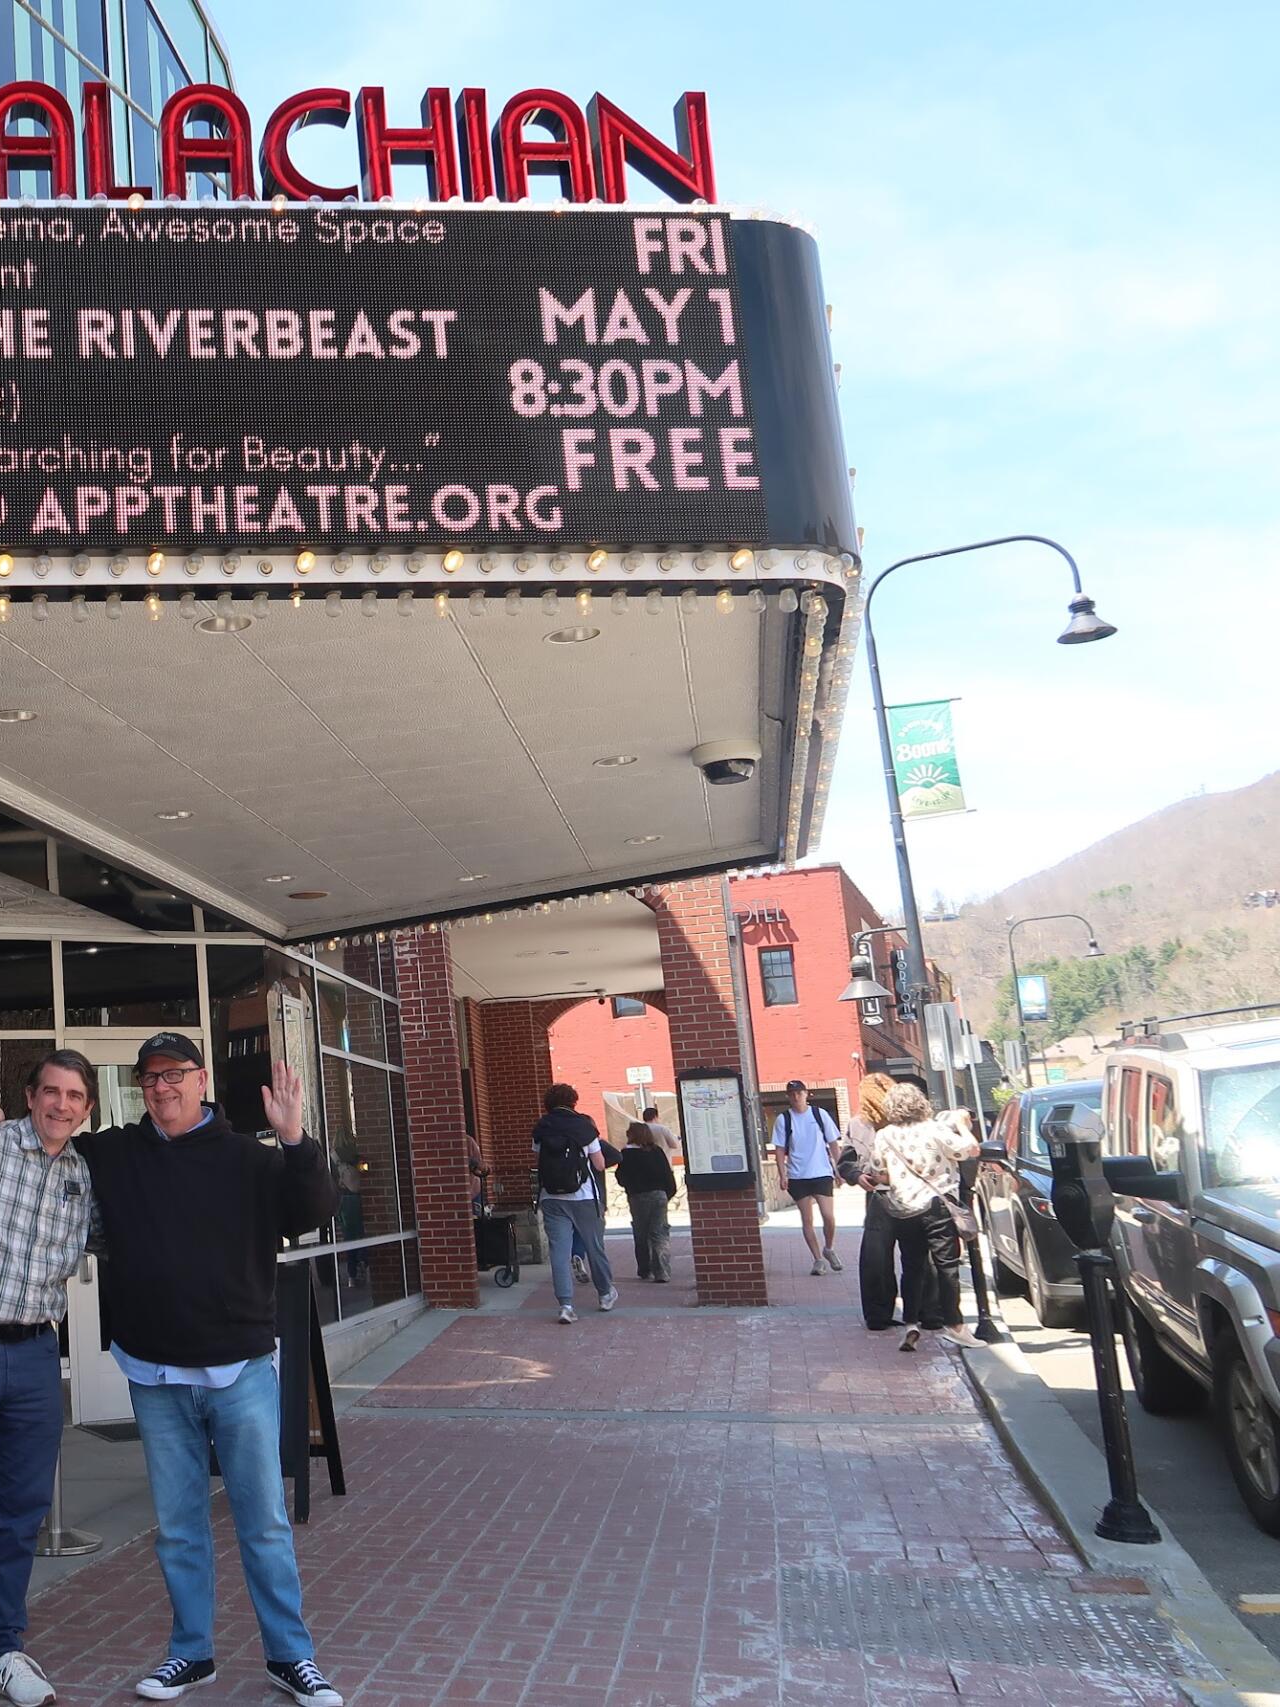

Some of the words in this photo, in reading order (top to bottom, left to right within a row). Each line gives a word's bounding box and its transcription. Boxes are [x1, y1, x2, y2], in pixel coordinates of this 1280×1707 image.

[100, 206, 300, 243] Awesome
[315, 210, 445, 252] Space
[633, 217, 727, 275] FRI
[78, 309, 457, 359] RIVERBEAST
[539, 287, 693, 345] MAY
[708, 288, 735, 345] 1
[508, 359, 744, 418] 8:30PM
[171, 434, 228, 471] for
[561, 427, 760, 492] FREE
[32, 484, 563, 533] APPTHEATRE.ORG
